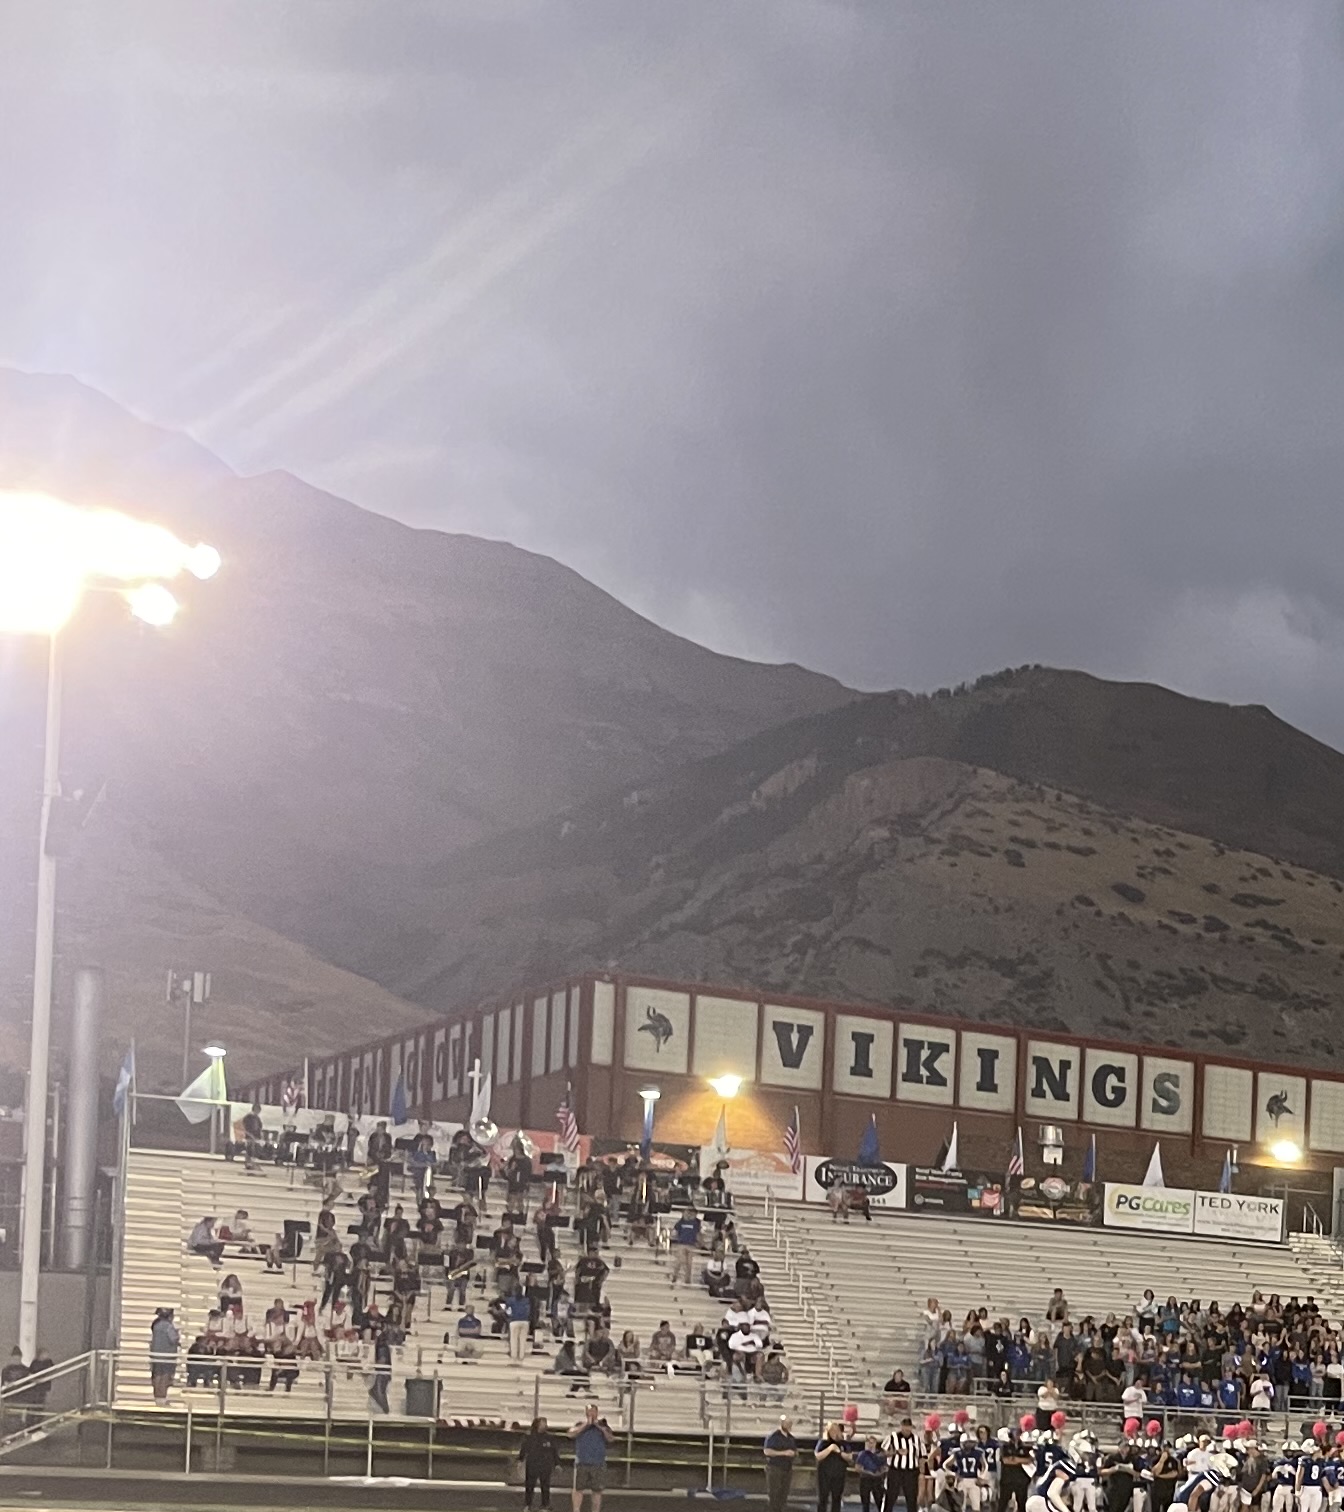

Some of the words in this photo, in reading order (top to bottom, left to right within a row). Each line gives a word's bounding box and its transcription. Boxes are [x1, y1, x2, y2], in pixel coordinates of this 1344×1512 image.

[773, 1020, 1180, 1116] VIKINGS
[821, 1167, 893, 1187] INURANCE
[1199, 1196, 1231, 1209] TED
[1237, 1200, 1279, 1214] YORK
[962, 1458, 977, 1473] 17
